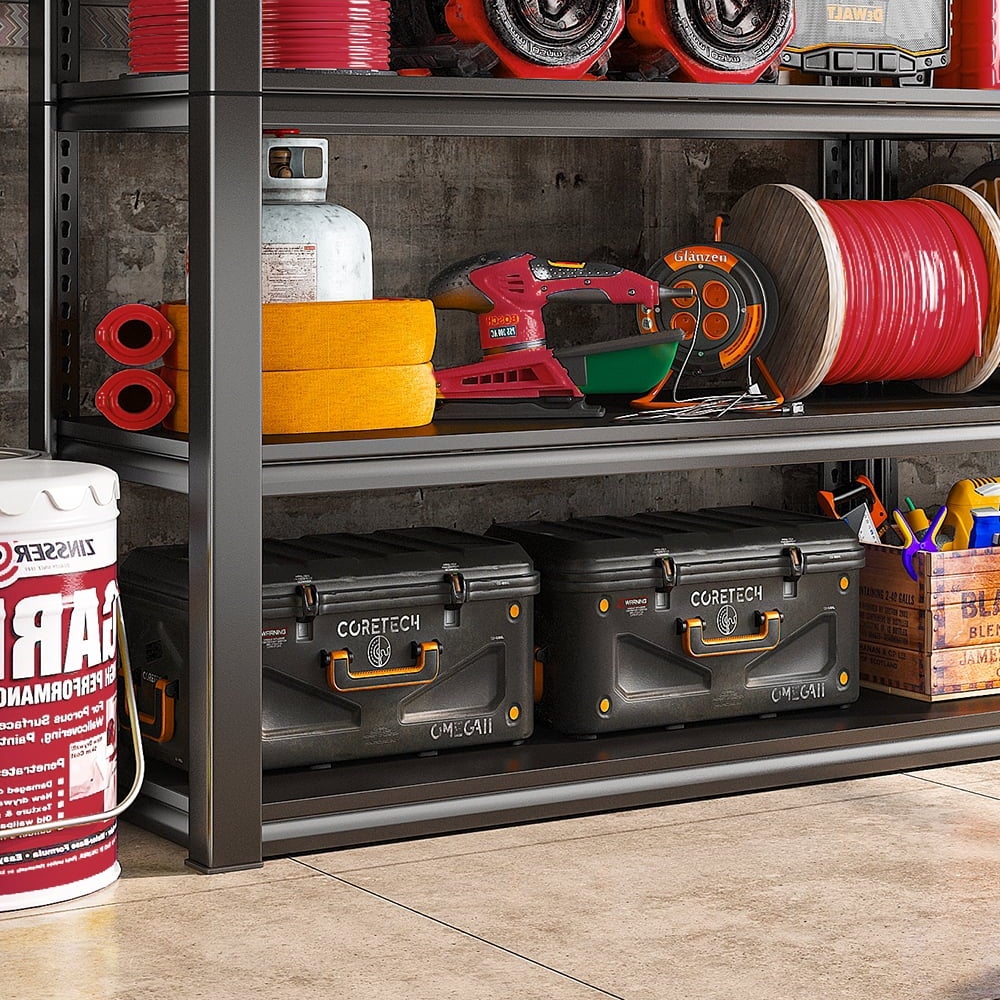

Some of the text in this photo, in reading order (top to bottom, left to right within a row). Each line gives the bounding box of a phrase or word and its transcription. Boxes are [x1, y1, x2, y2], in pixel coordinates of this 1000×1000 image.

[674, 250, 727, 263] Glänzen
[691, 586, 763, 607] CORETECH
[337, 614, 420, 637] CORETECH
